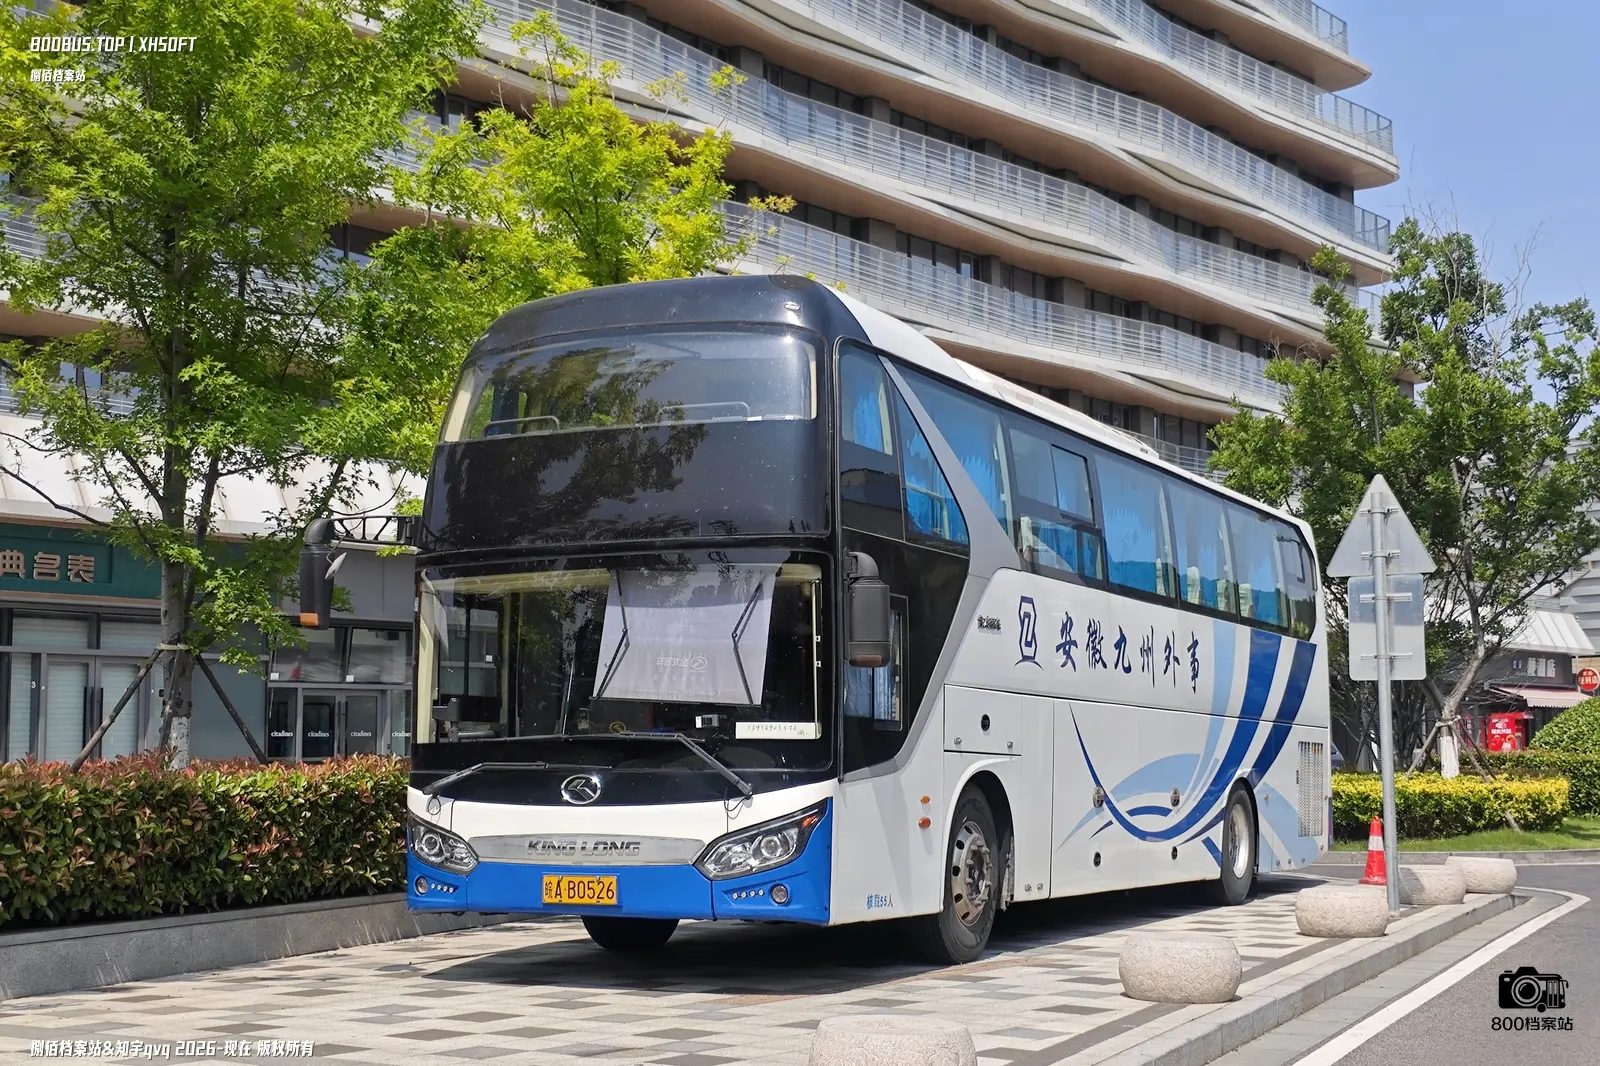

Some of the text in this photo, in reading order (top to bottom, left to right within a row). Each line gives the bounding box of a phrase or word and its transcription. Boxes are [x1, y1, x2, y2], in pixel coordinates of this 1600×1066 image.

[0, 549, 95, 583] 典名表
[1055, 611, 1200, 694] 安徽九州外事
[527, 840, 642, 857] KING LONG
